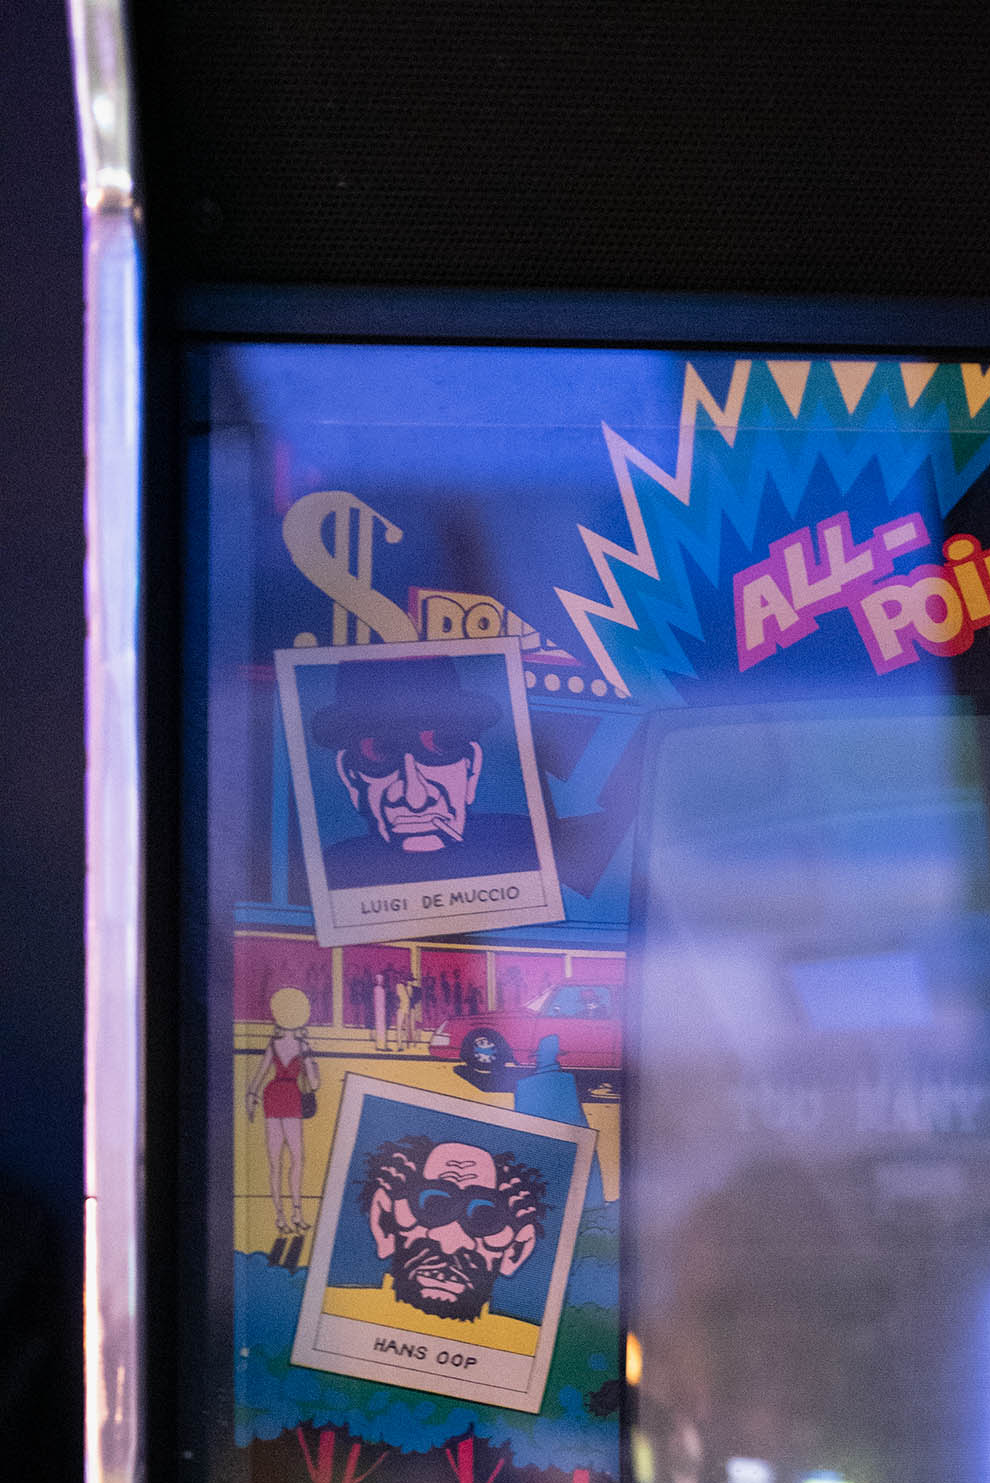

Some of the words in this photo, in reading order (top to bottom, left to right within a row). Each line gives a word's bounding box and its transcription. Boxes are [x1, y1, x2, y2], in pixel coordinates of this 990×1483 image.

[361, 899, 408, 914] LUIGI
[422, 894, 444, 909] DE
[450, 886, 520, 906] MUCCIO
[373, 1338, 428, 1360] HANS
[436, 1351, 477, 1369] OOP
